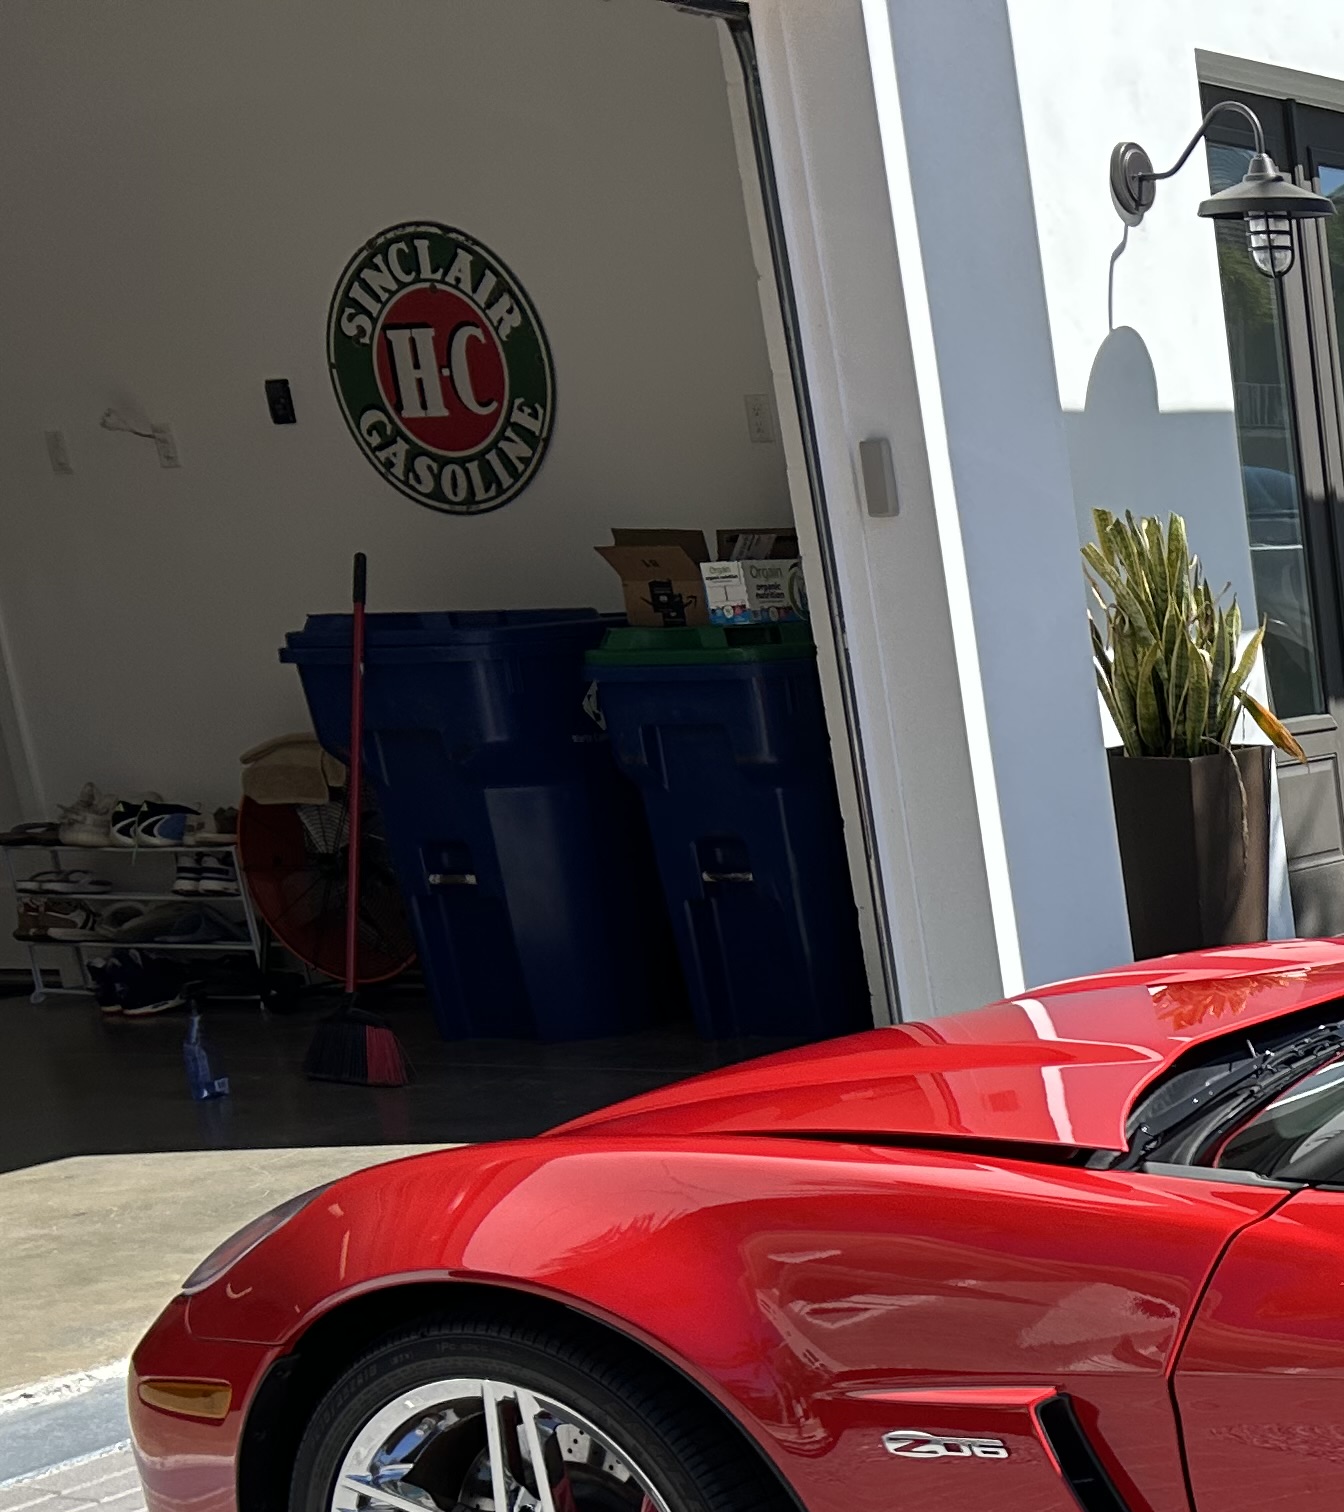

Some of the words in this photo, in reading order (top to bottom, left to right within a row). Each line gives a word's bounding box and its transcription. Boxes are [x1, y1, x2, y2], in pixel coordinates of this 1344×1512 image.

[340, 238, 522, 344] SINCLAIR
[359, 397, 544, 502] GASOLINE
[750, 564, 783, 580] Orgain
[882, 1430, 1009, 1458] Z06
